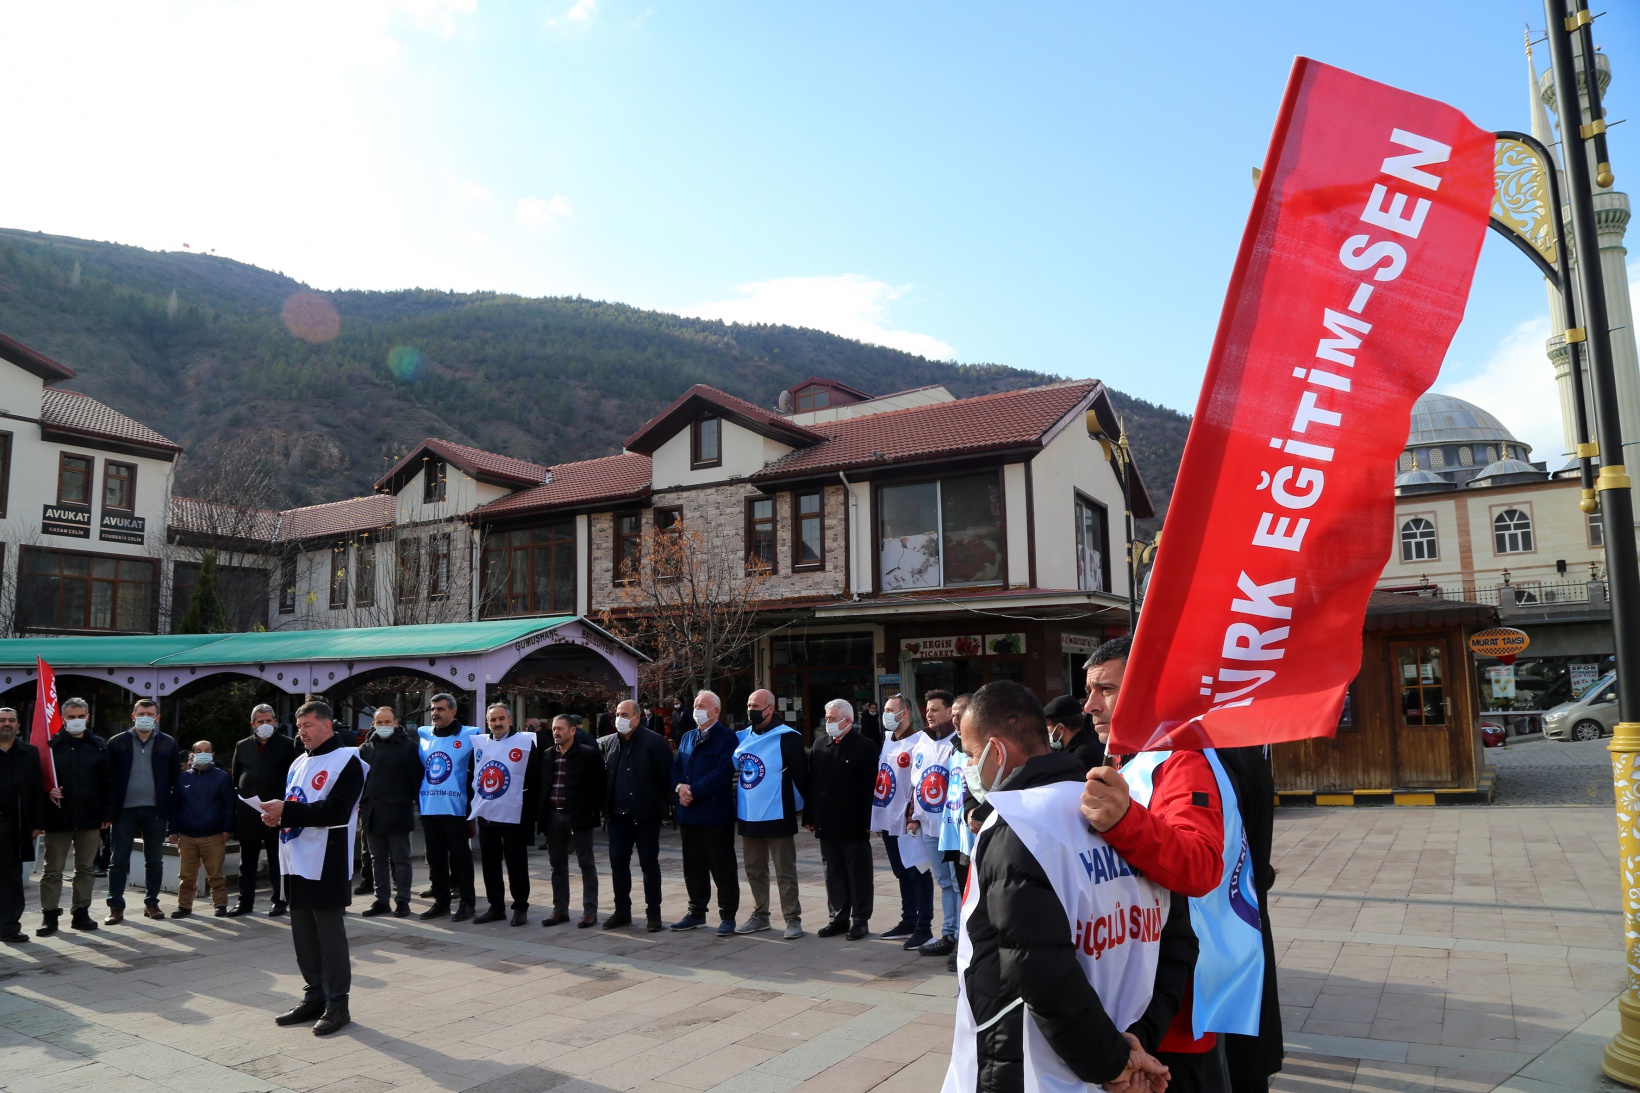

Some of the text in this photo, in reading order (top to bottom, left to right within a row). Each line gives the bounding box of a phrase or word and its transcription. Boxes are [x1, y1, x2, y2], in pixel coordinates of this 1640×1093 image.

[1190, 126, 1452, 723] ÜRK EĞİTİM-SEN
[45, 508, 90, 522] AVUKAT
[102, 516, 144, 529] AVUKAT
[48, 526, 68, 534] HASAN
[922, 640, 952, 649] ERGİN
[1471, 636, 1525, 647] MURAT TAKSİ
[919, 650, 955, 658] TİCARET
